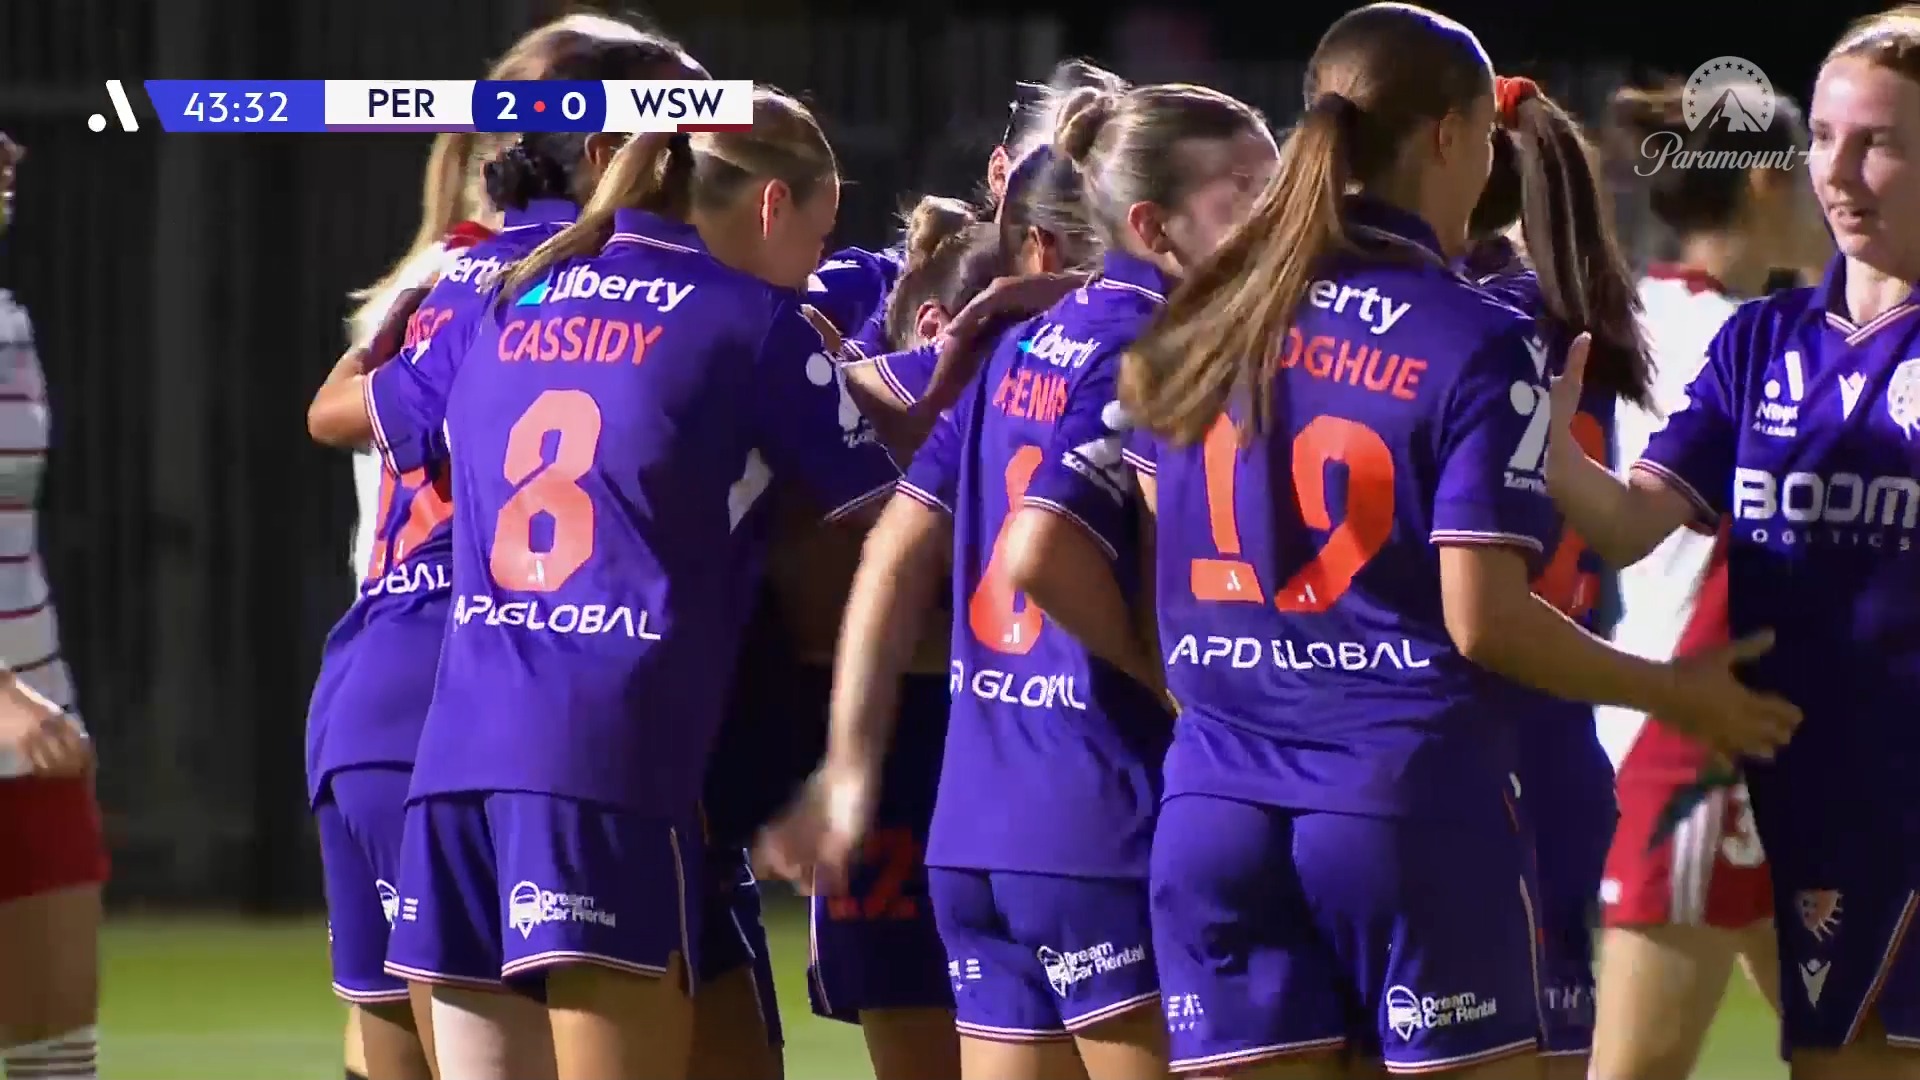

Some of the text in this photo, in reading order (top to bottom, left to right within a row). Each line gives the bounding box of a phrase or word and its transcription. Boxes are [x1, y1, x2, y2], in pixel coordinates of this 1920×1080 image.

[548, 264, 695, 313] Liberty
[1309, 279, 1412, 335] erty
[498, 317, 663, 366] CASSIDY
[1280, 327, 1428, 399] OGHUE
[490, 388, 602, 591] 8
[1190, 412, 1396, 612] 19
[1734, 466, 1920, 528] BOOM
[499, 601, 661, 640] GLOBAL
[1168, 634, 1263, 668] APD
